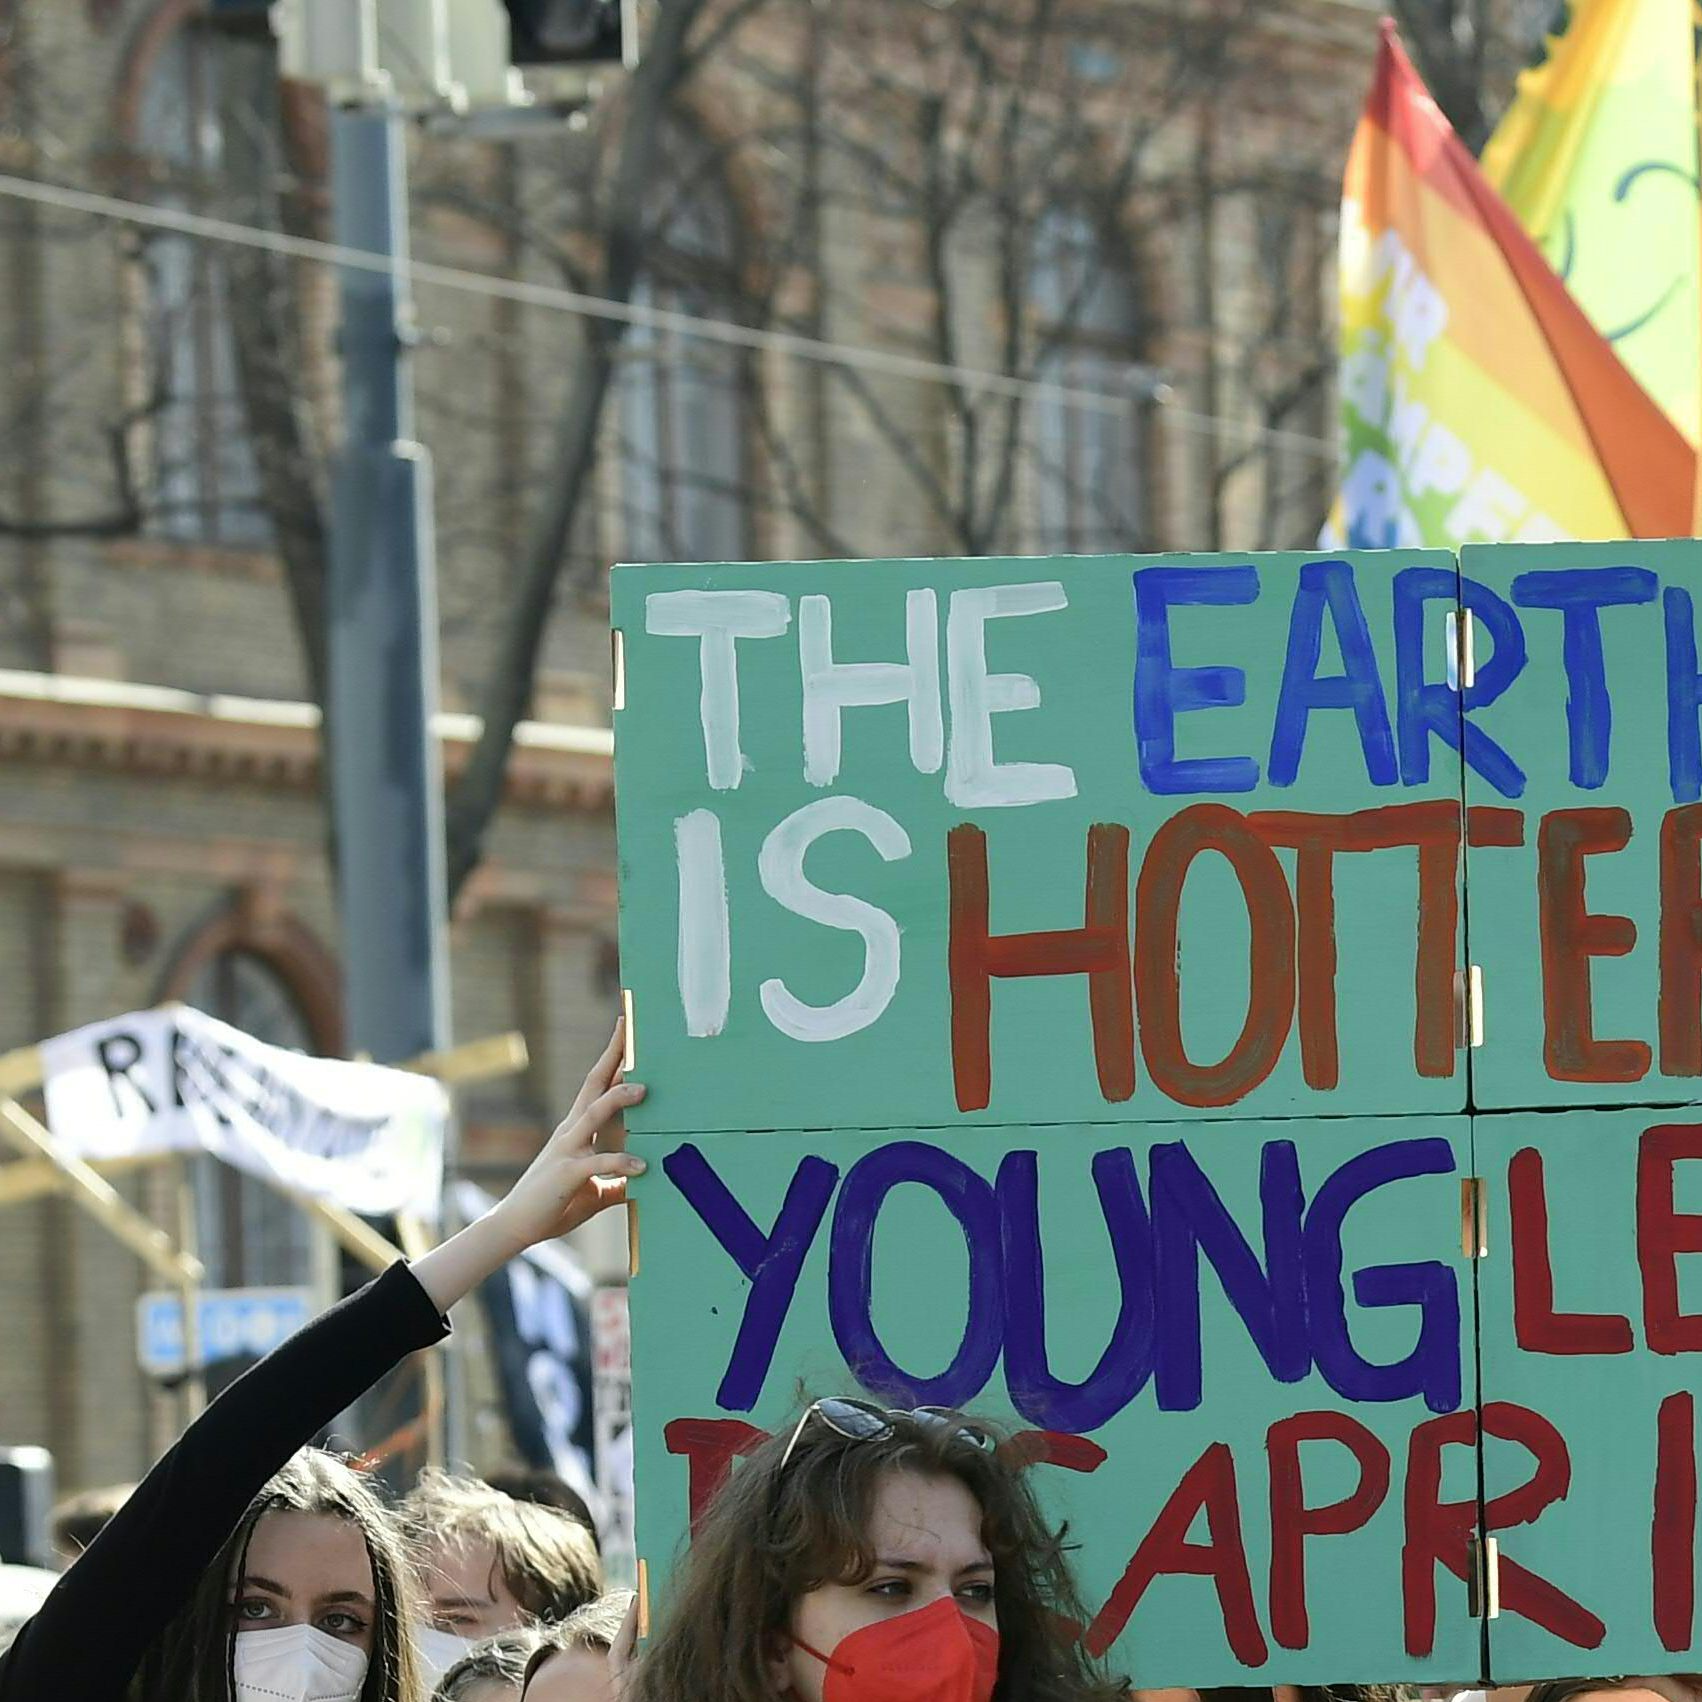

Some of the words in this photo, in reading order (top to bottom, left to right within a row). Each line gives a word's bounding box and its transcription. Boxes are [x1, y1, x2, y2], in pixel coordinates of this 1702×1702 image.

[645, 581, 1078, 808] THE
[674, 795, 912, 1042] IS
[662, 1136, 1463, 1433] YOUNG
